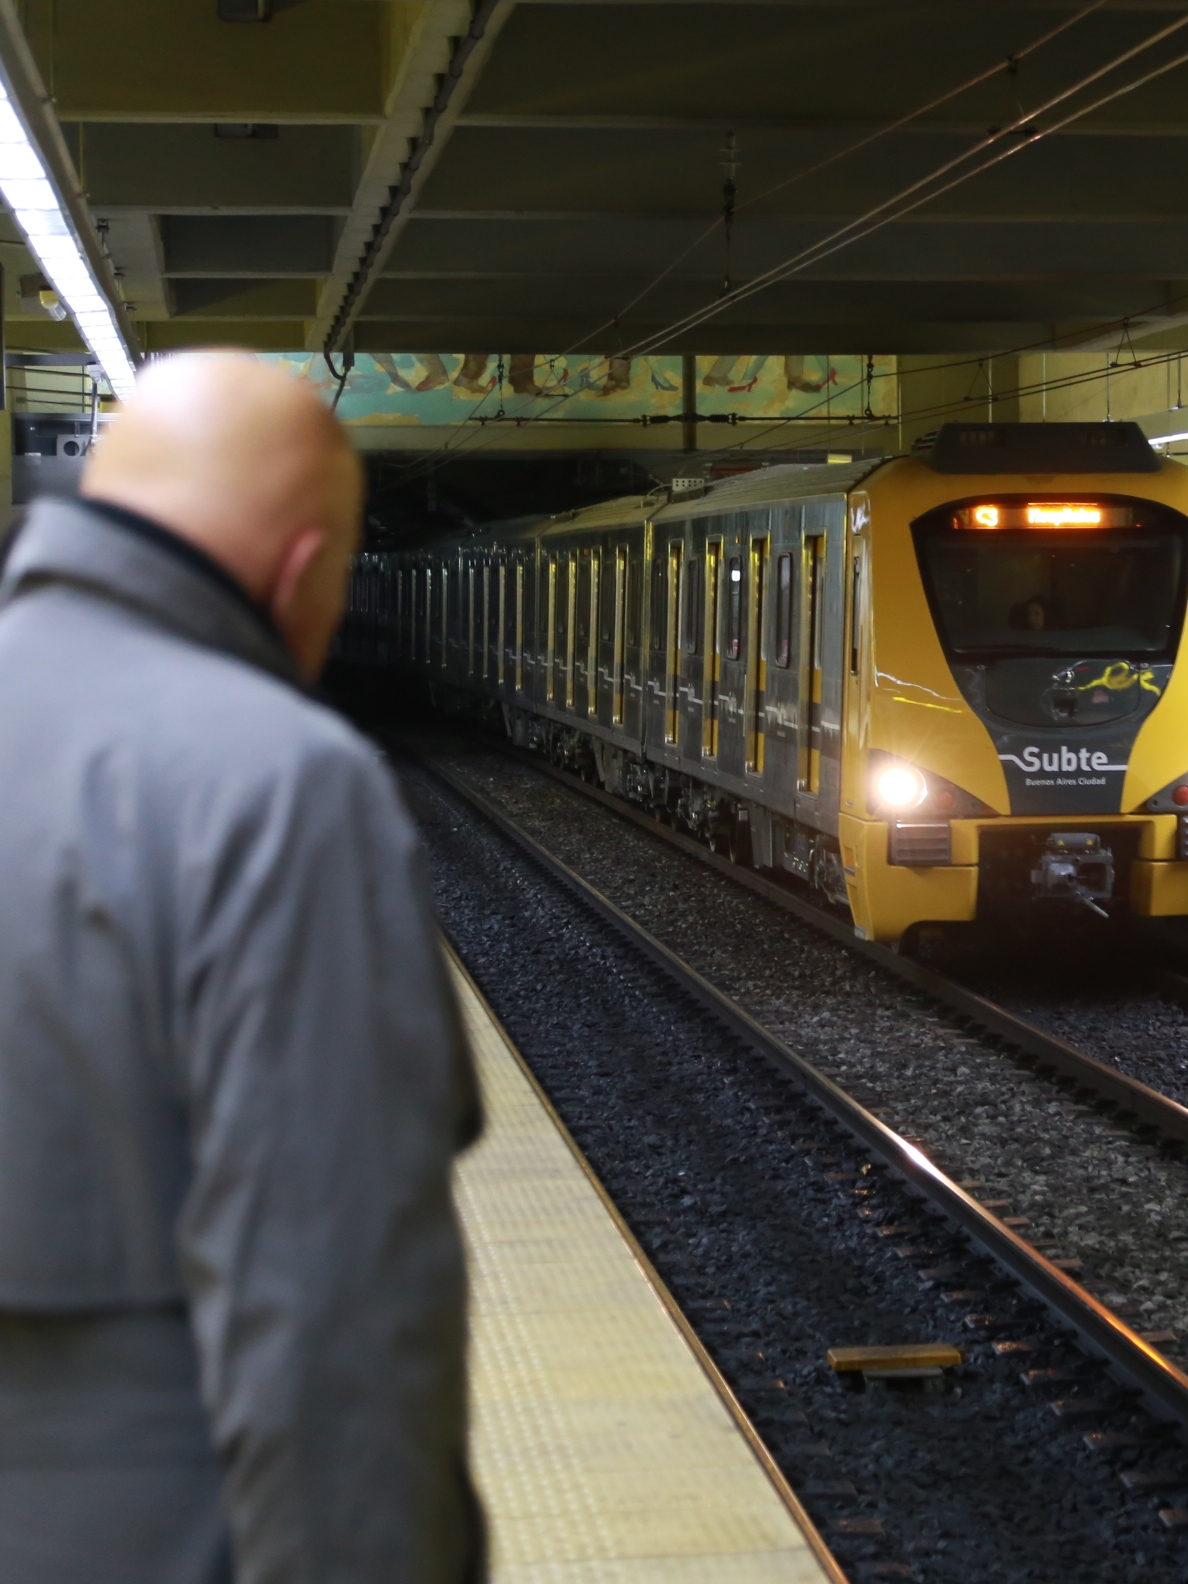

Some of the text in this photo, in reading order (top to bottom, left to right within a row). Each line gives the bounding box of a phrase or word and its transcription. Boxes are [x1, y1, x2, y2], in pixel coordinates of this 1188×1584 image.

[1020, 745, 1109, 772] Subte
[1025, 776, 1106, 786] Buenos Aires Ciudad
